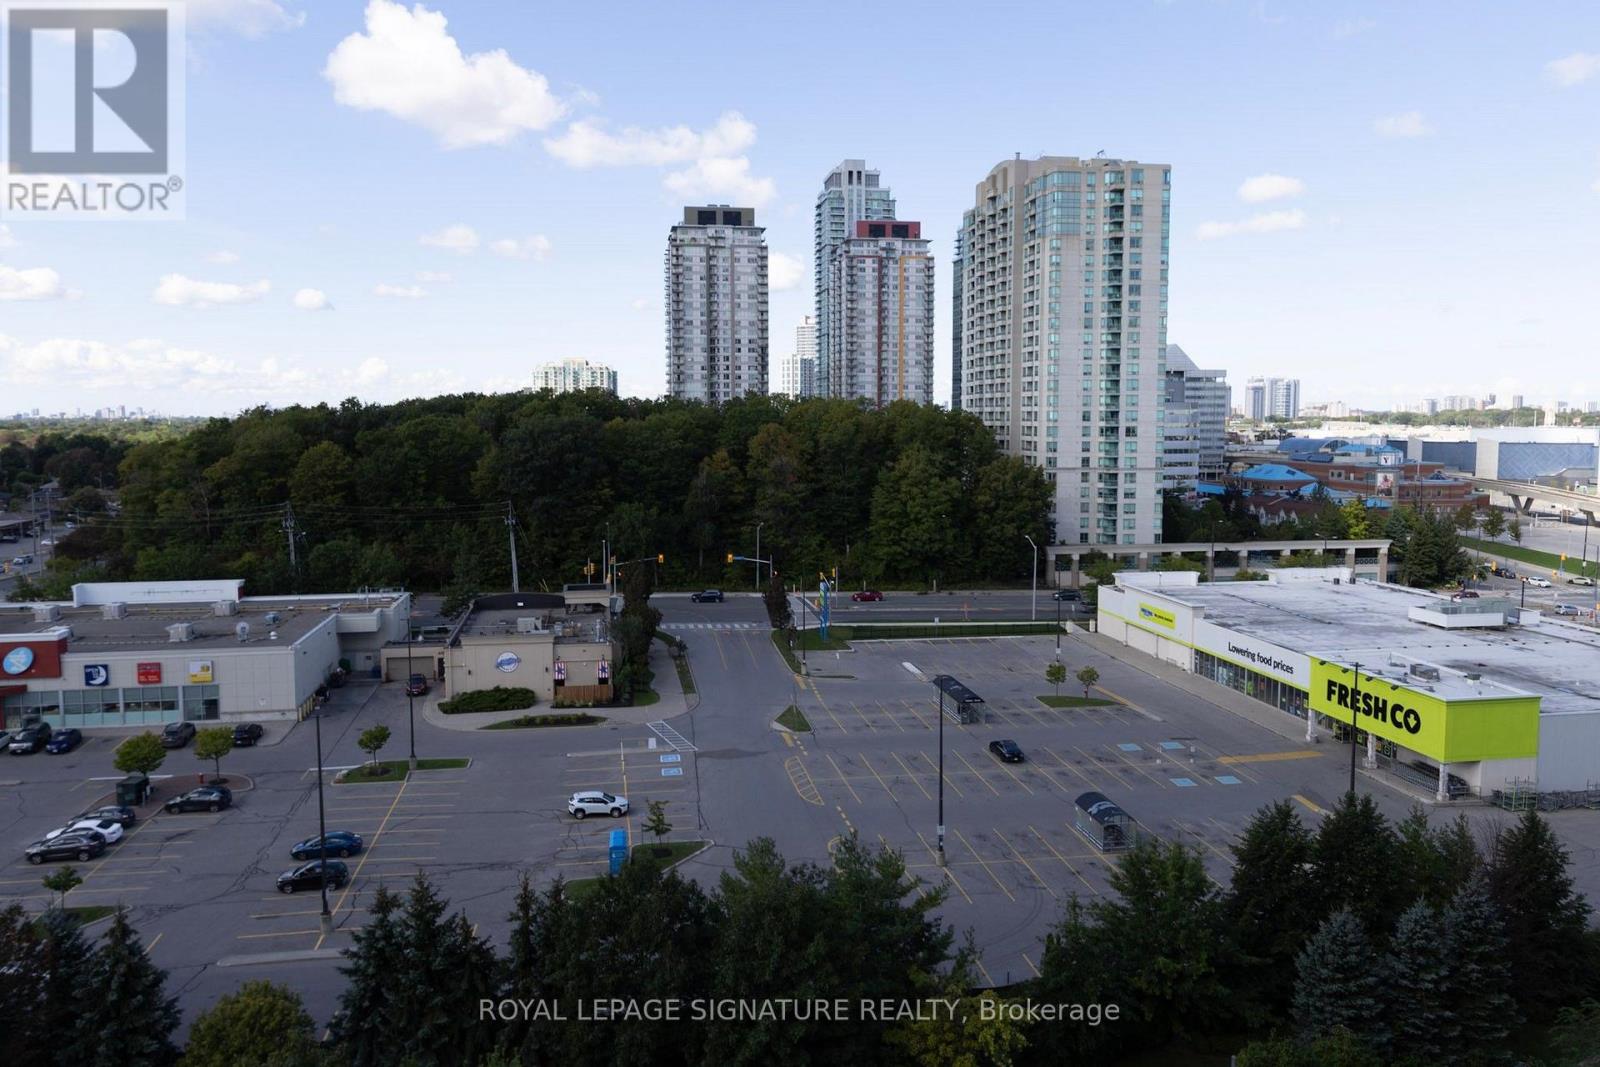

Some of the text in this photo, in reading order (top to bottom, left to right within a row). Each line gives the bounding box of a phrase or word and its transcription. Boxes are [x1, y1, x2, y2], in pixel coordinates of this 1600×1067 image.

[1228, 641, 1294, 674] Lowering food prices
